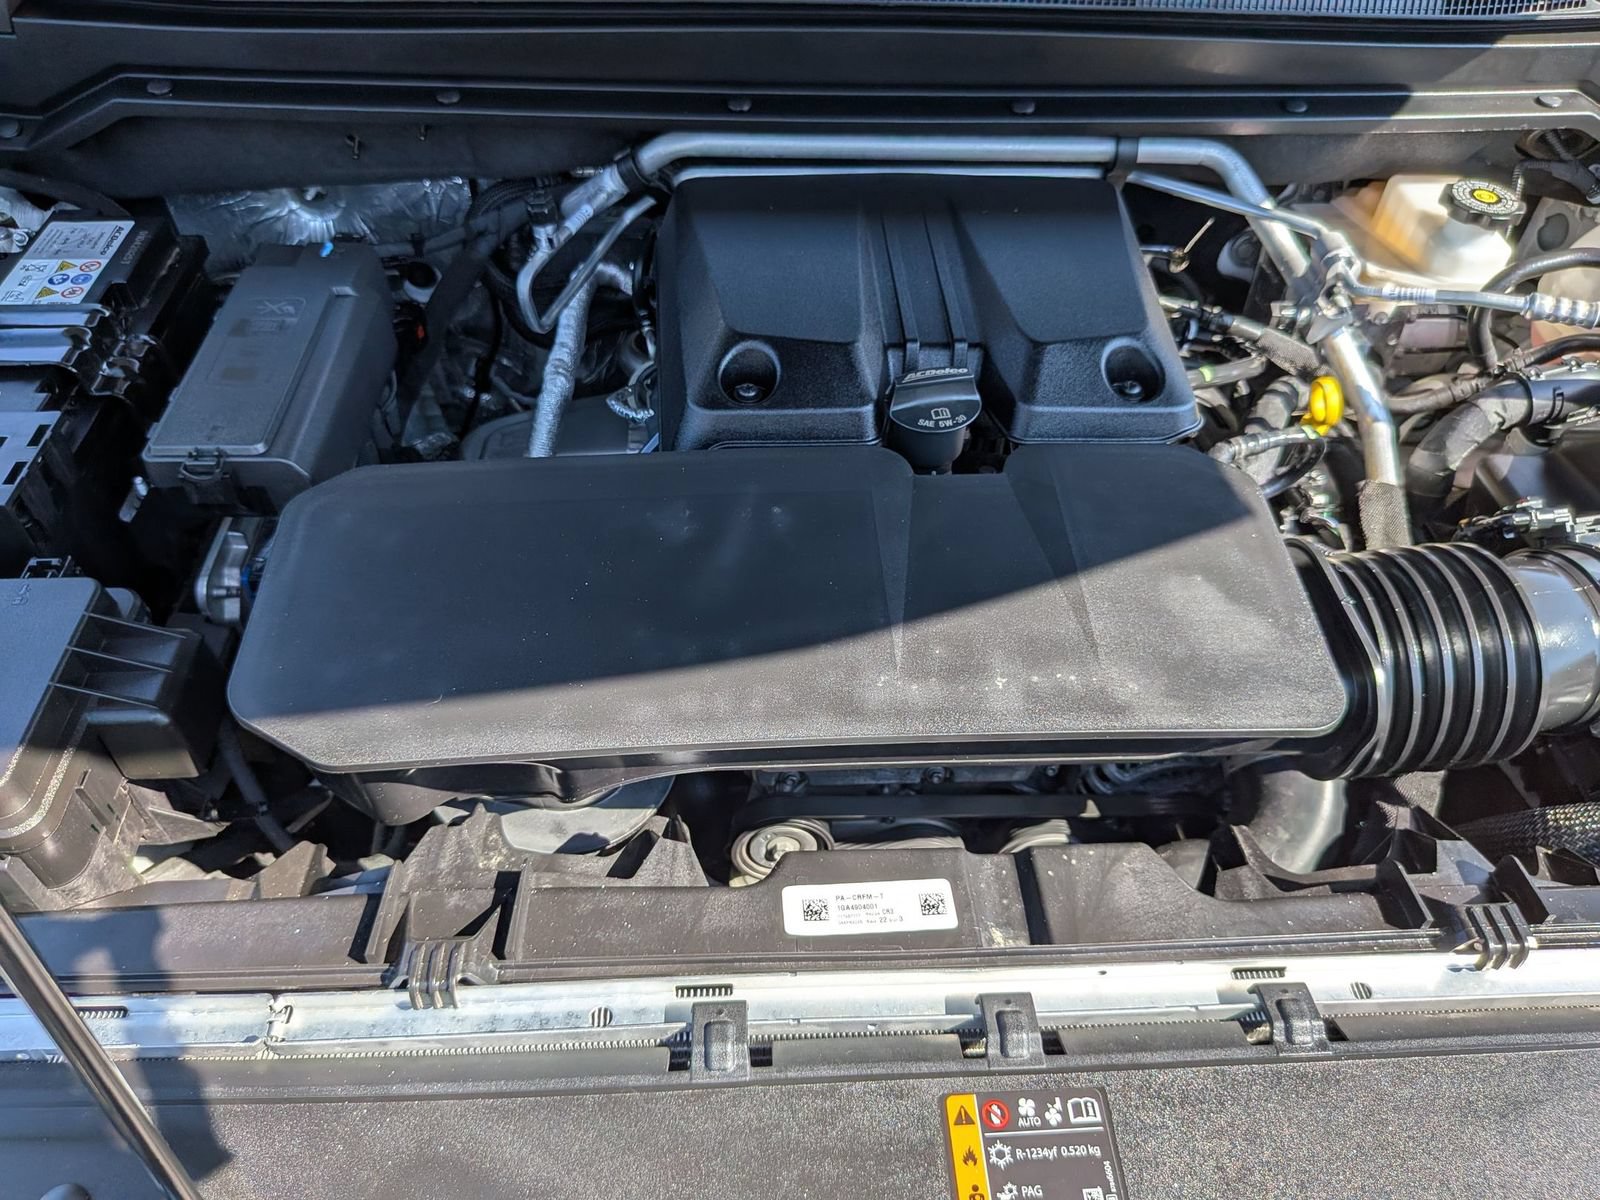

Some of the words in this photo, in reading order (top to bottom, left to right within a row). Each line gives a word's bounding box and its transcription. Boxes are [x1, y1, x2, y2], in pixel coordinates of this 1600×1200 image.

[100, 226, 125, 255] ACDelco
[902, 368, 969, 382] ACDelco
[918, 419, 935, 427] SAE
[939, 414, 967, 427] 5W-30
[1018, 1117, 1041, 1127] AUTO
[1016, 1146, 1058, 1161] R-1234yf
[1061, 1145, 1087, 1157] 0.520
[1087, 1143, 1101, 1157] kg
[1021, 1185, 1043, 1198] PAG
